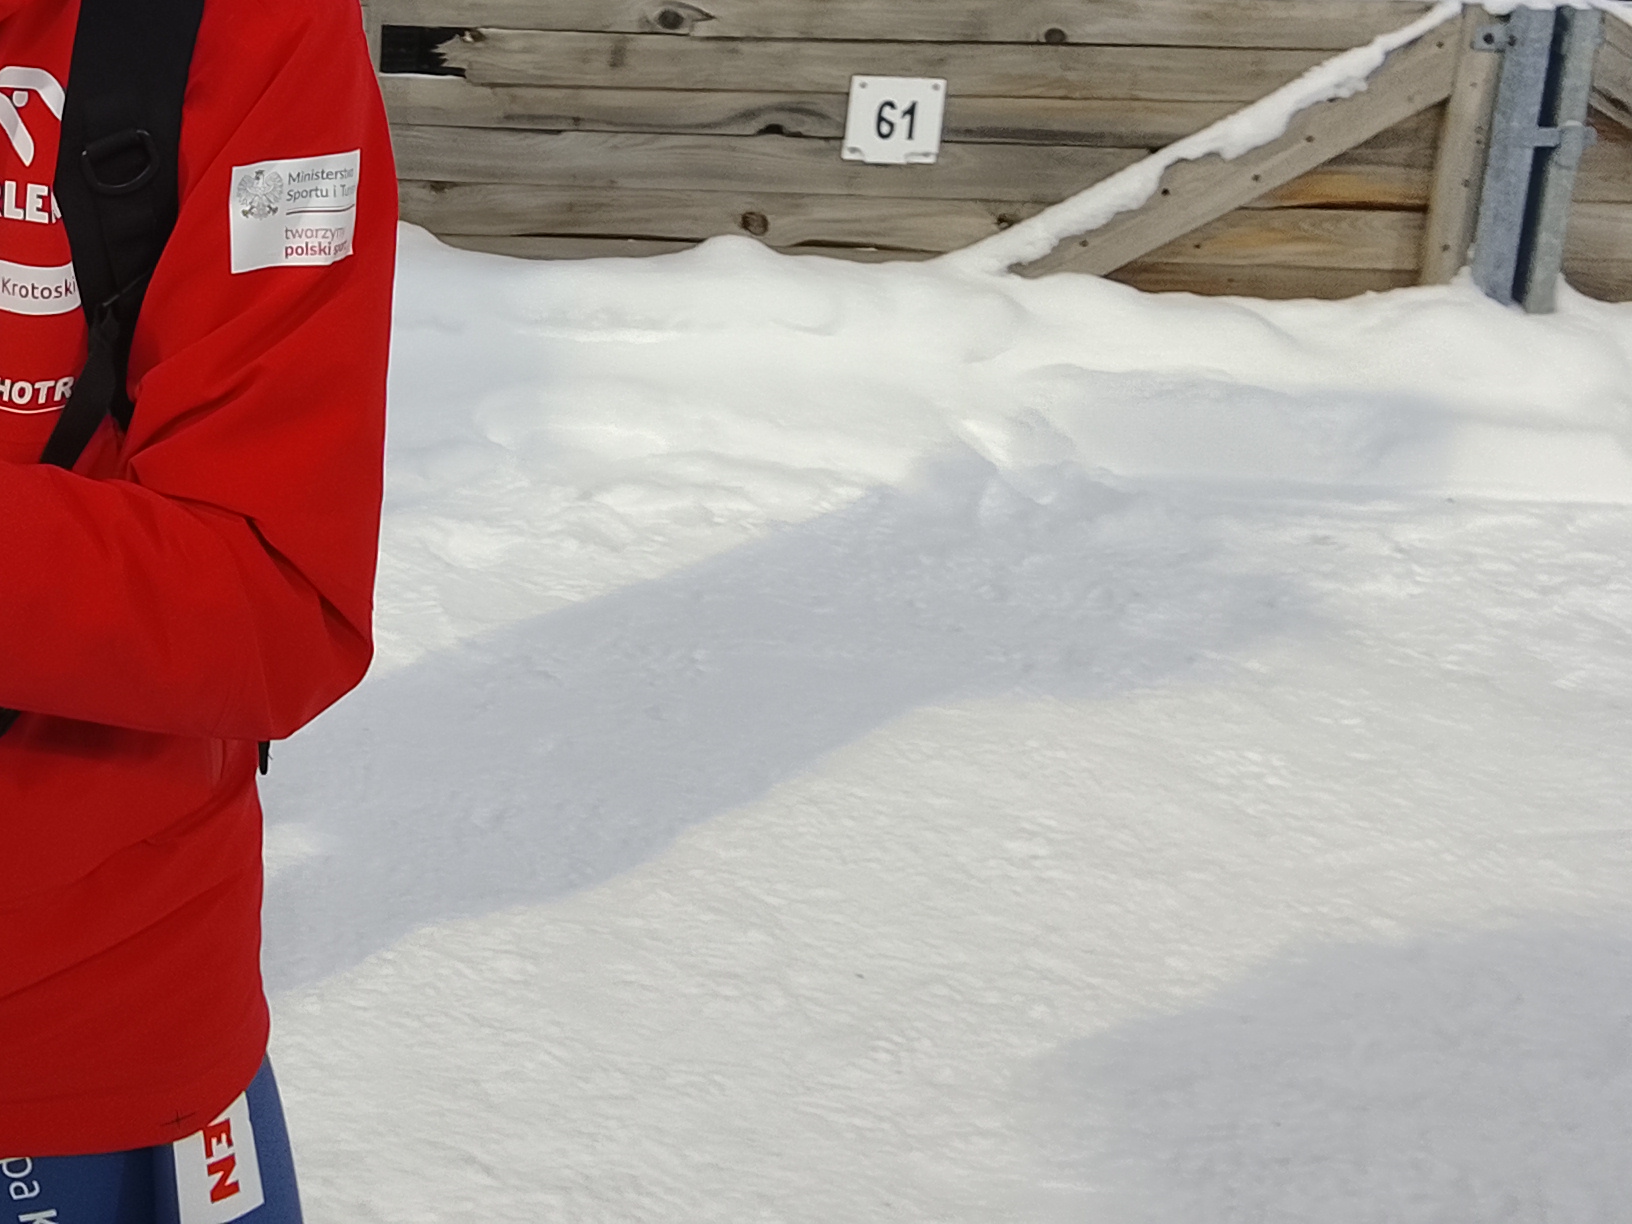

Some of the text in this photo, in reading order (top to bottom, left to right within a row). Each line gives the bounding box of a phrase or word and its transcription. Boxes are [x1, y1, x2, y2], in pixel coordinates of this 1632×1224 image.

[875, 100, 919, 141] 61
[286, 185, 329, 204] Sportu
[284, 241, 332, 259] polski
